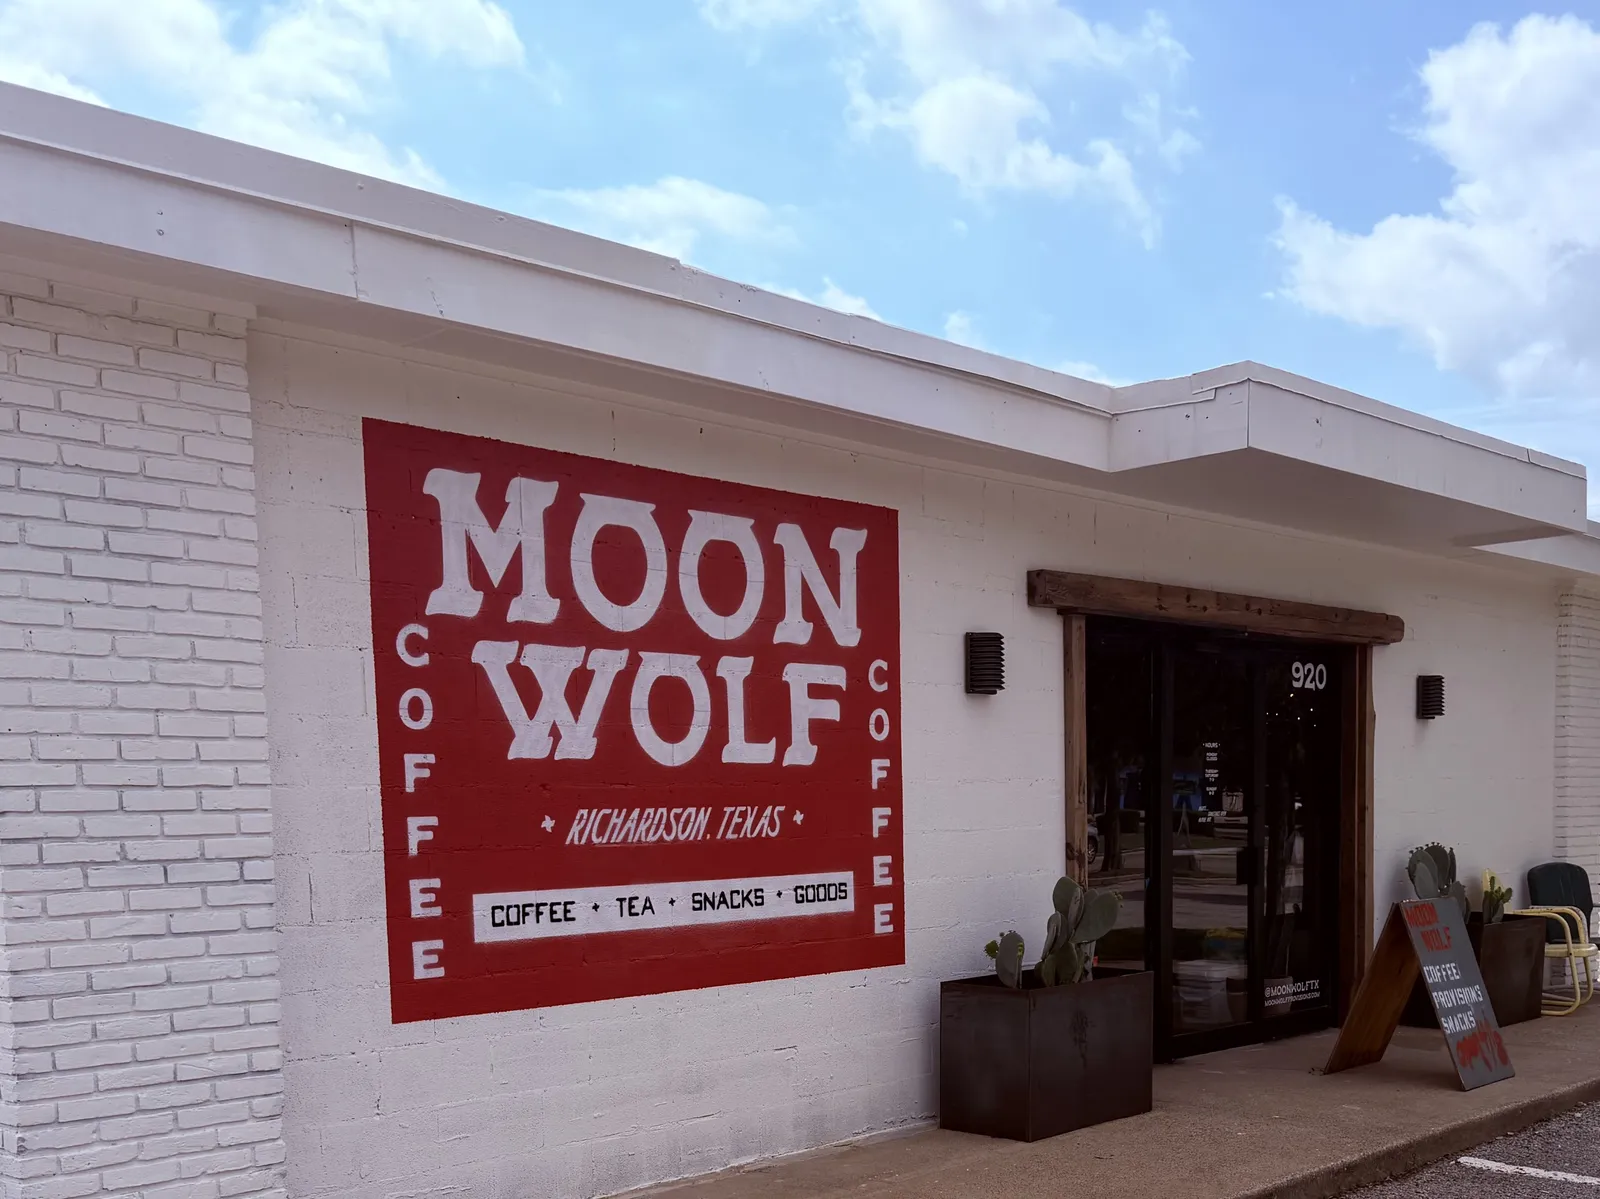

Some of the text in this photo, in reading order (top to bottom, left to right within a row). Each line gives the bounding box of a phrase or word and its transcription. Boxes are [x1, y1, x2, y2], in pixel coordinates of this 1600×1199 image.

[423, 467, 867, 647] MOON
[1291, 661, 1327, 691] 920
[472, 640, 846, 767] WOLF
[396, 623, 446, 981] COFFEE
[868, 659, 894, 934] COFFEE
[716, 805, 786, 839] TEXAS
[491, 882, 848, 927] COFFEE TEA SNACKS GOODS
[1404, 903, 1439, 928] MOON
[1421, 926, 1452, 952] WOLF
[1432, 984, 1483, 1010] PROVISIONS
[1441, 1010, 1476, 1034] SNACKS
